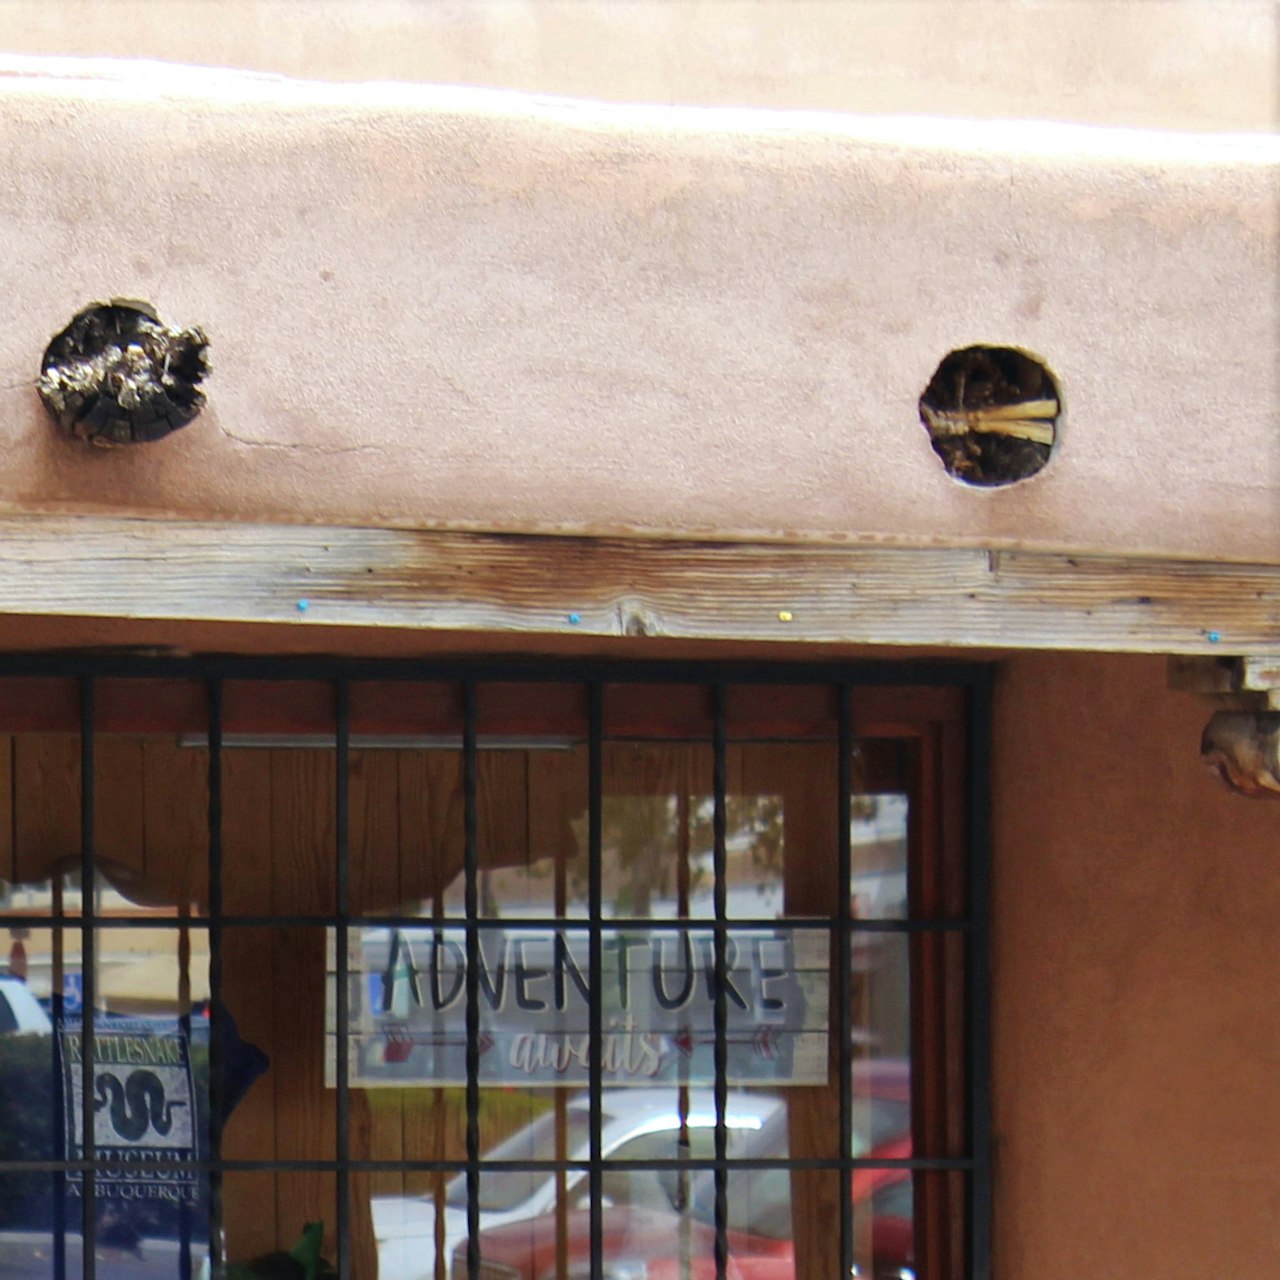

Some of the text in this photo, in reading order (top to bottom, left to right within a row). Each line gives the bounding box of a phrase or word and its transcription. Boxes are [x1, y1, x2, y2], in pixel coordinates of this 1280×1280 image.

[382, 926, 790, 1012] ADVENTURE
[68, 1034, 186, 1063] RTTLESNAKE
[65, 1181, 201, 1201] ABUQUERQUE
